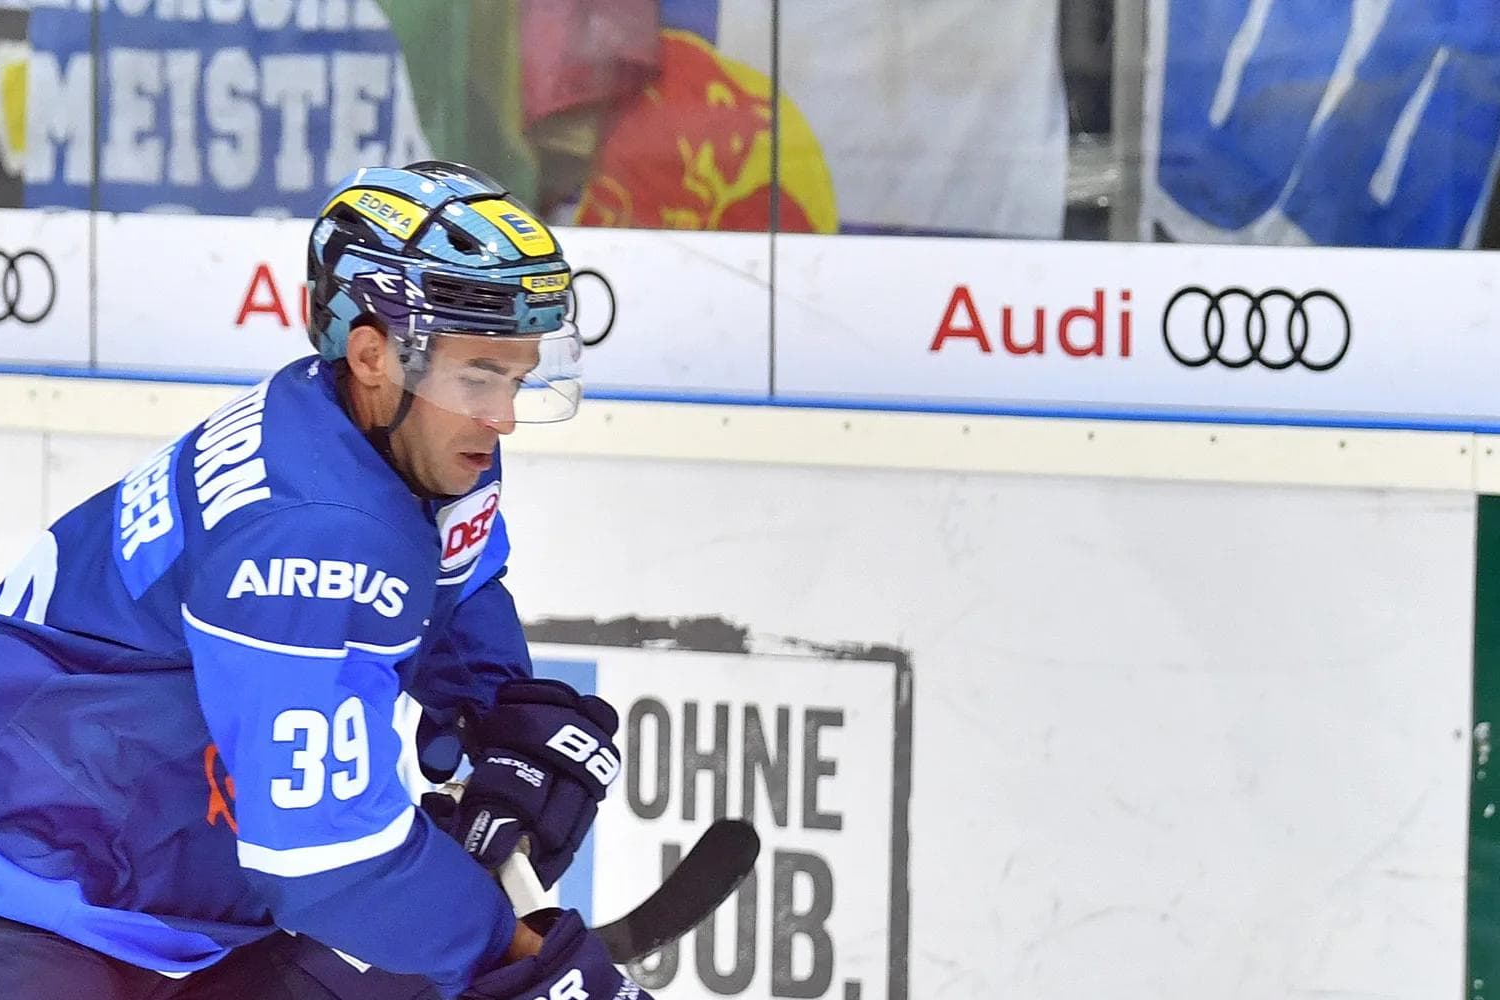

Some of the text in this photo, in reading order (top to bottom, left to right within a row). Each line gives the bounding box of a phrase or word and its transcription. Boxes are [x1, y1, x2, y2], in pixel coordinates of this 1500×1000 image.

[359, 192, 412, 229] EDEKA
[929, 284, 1133, 359] Audi
[226, 556, 410, 618] AIRBUS
[270, 697, 370, 810] 39
[626, 696, 845, 832] OHNE
